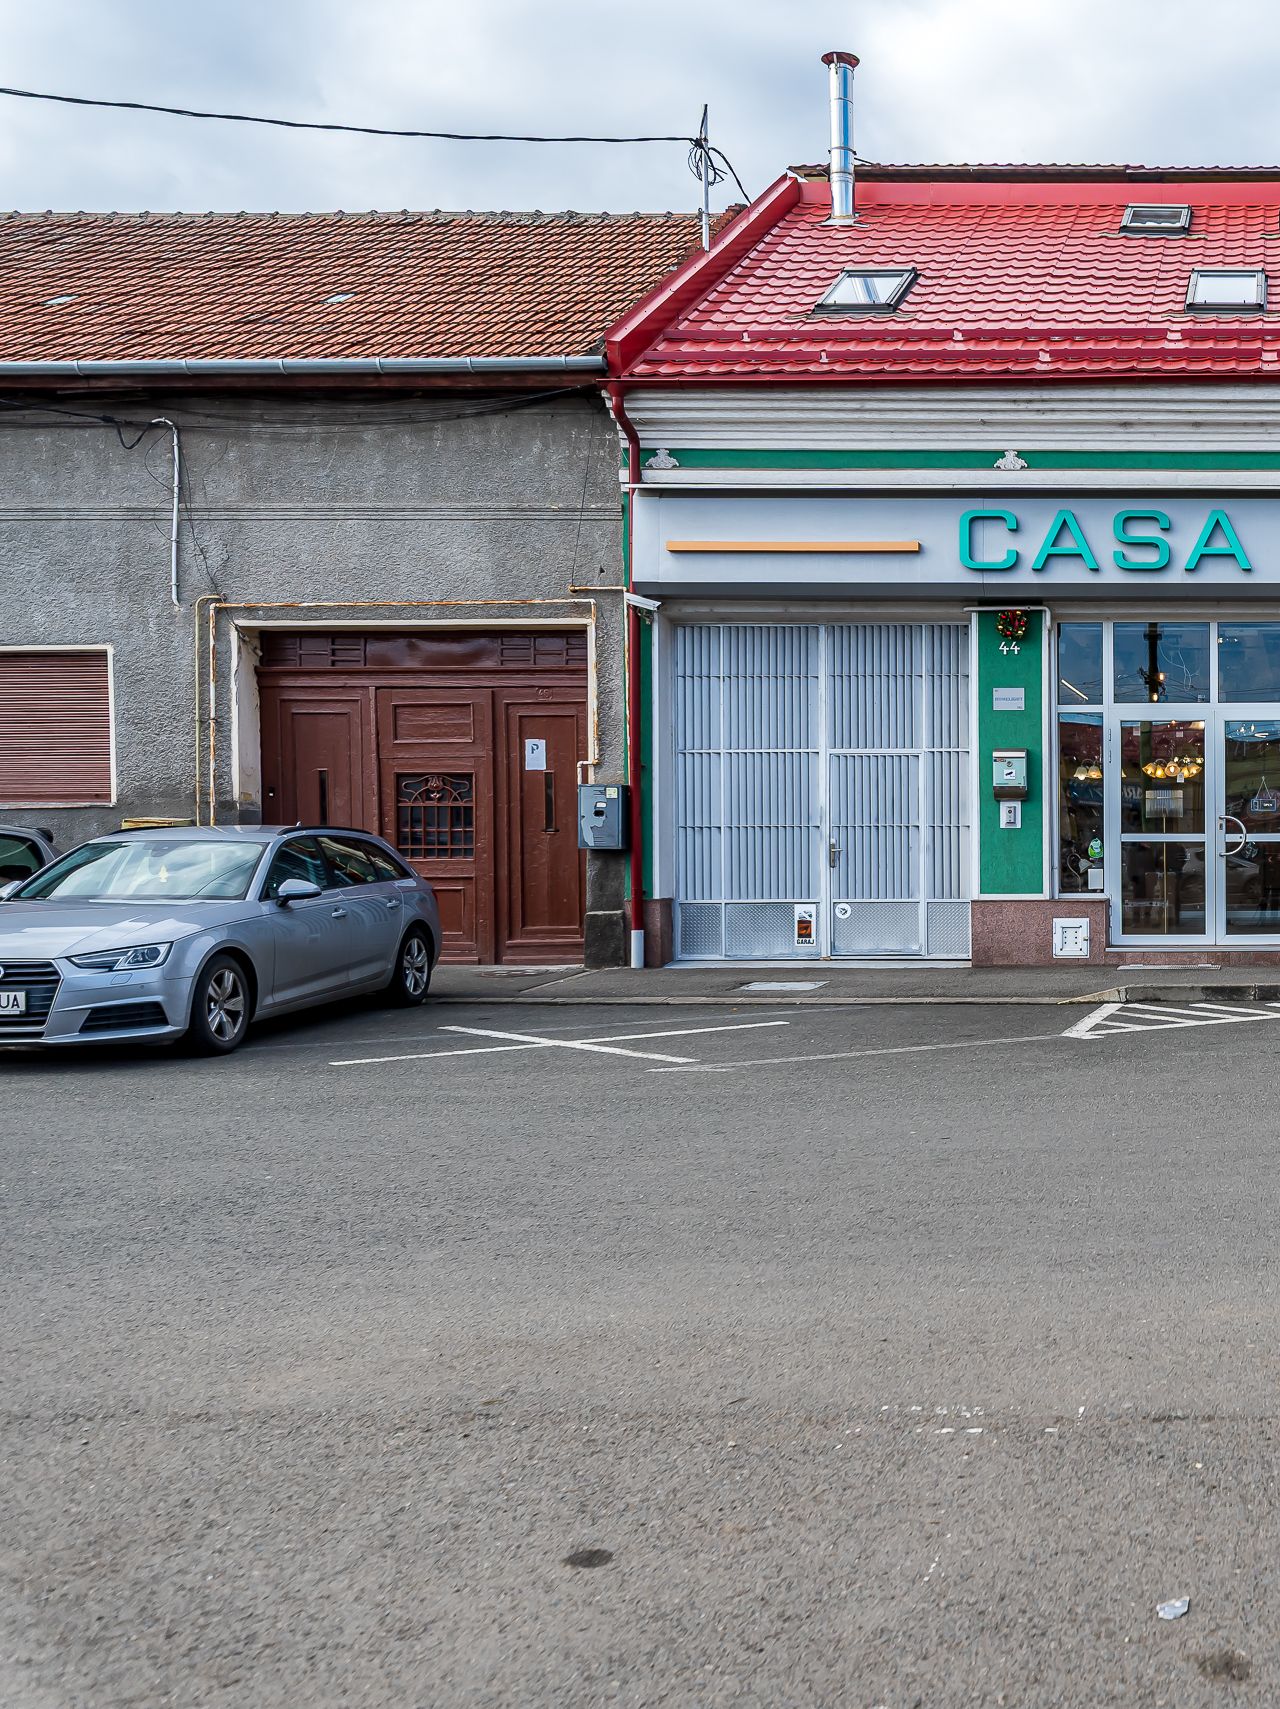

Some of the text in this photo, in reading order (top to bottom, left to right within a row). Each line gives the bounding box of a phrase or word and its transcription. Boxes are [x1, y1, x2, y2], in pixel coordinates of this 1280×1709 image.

[959, 509, 1252, 571] CASA
[999, 641, 1020, 655] 44
[0, 994, 20, 1009] UA
